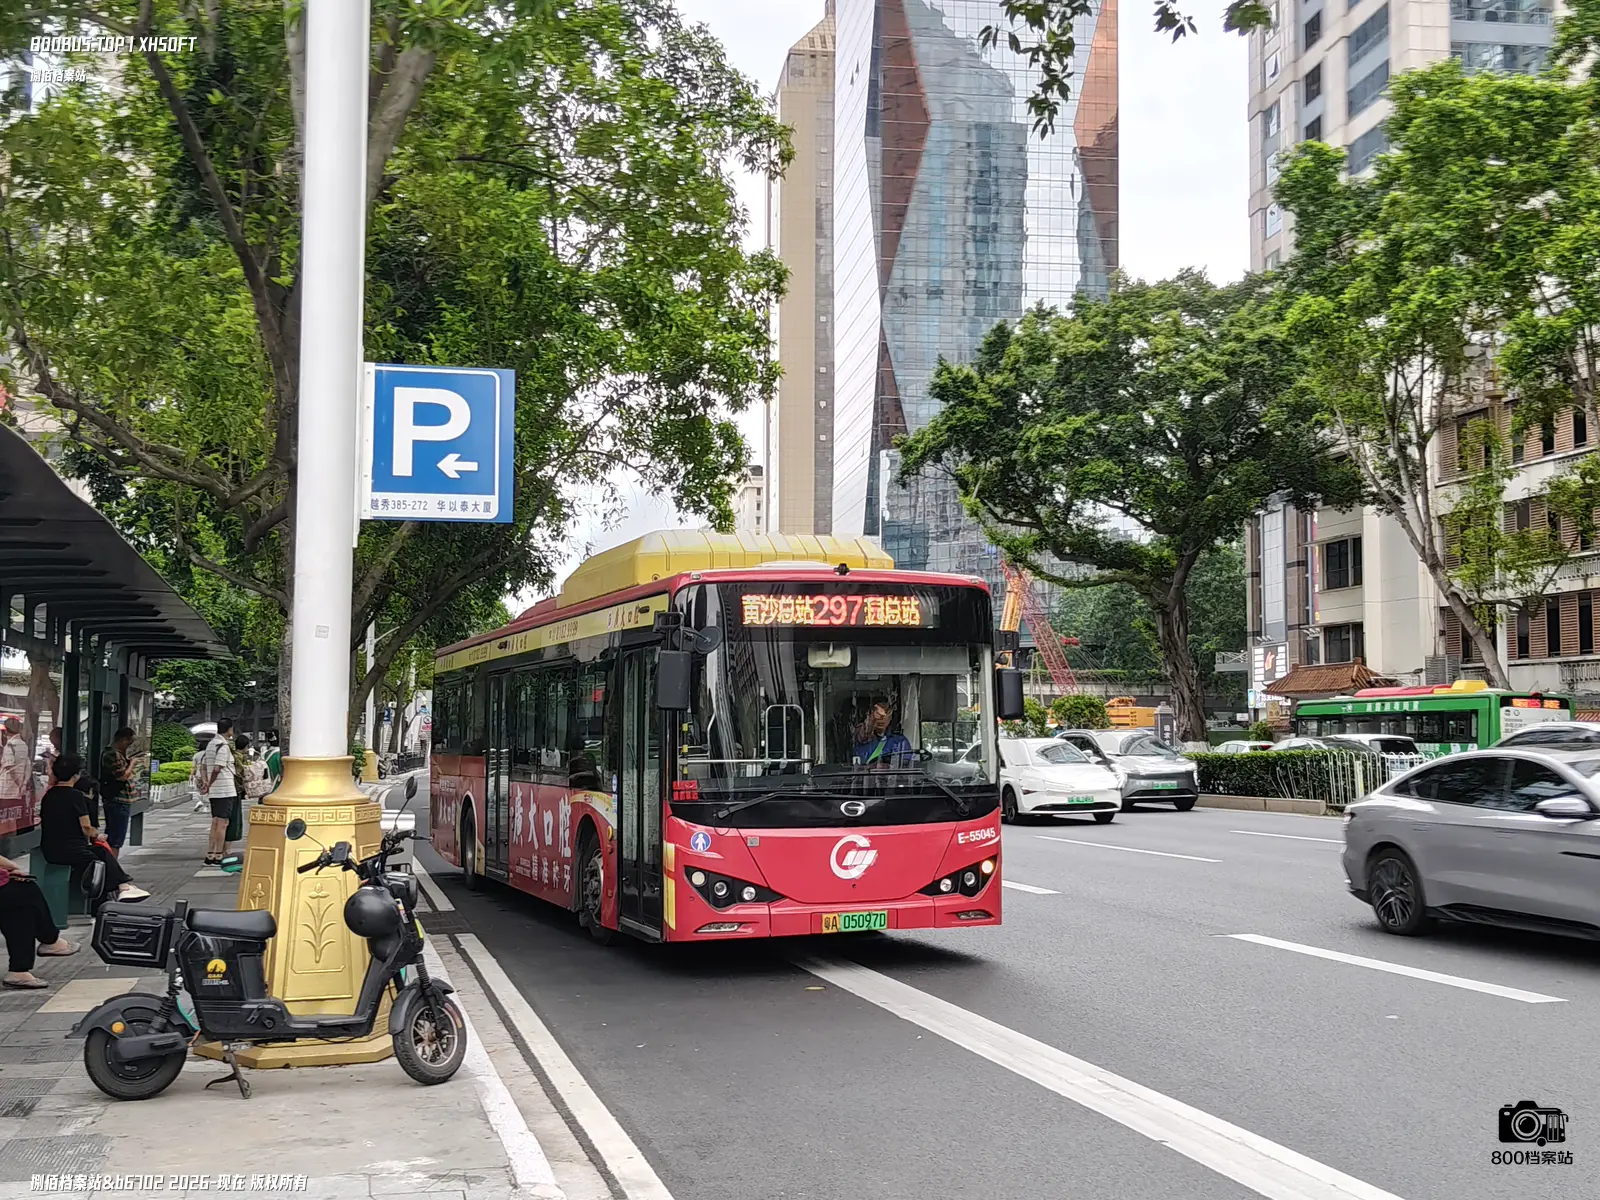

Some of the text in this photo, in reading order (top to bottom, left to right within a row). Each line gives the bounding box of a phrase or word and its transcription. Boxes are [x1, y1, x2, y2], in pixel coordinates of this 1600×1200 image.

[392, 387, 471, 477] P
[371, 498, 492, 513] 越秀385-272 华以泰大厦
[741, 595, 920, 625] 黄沙总站 297 园总站
[957, 827, 996, 844] E-55045
[843, 913, 886, 929] 05097D
